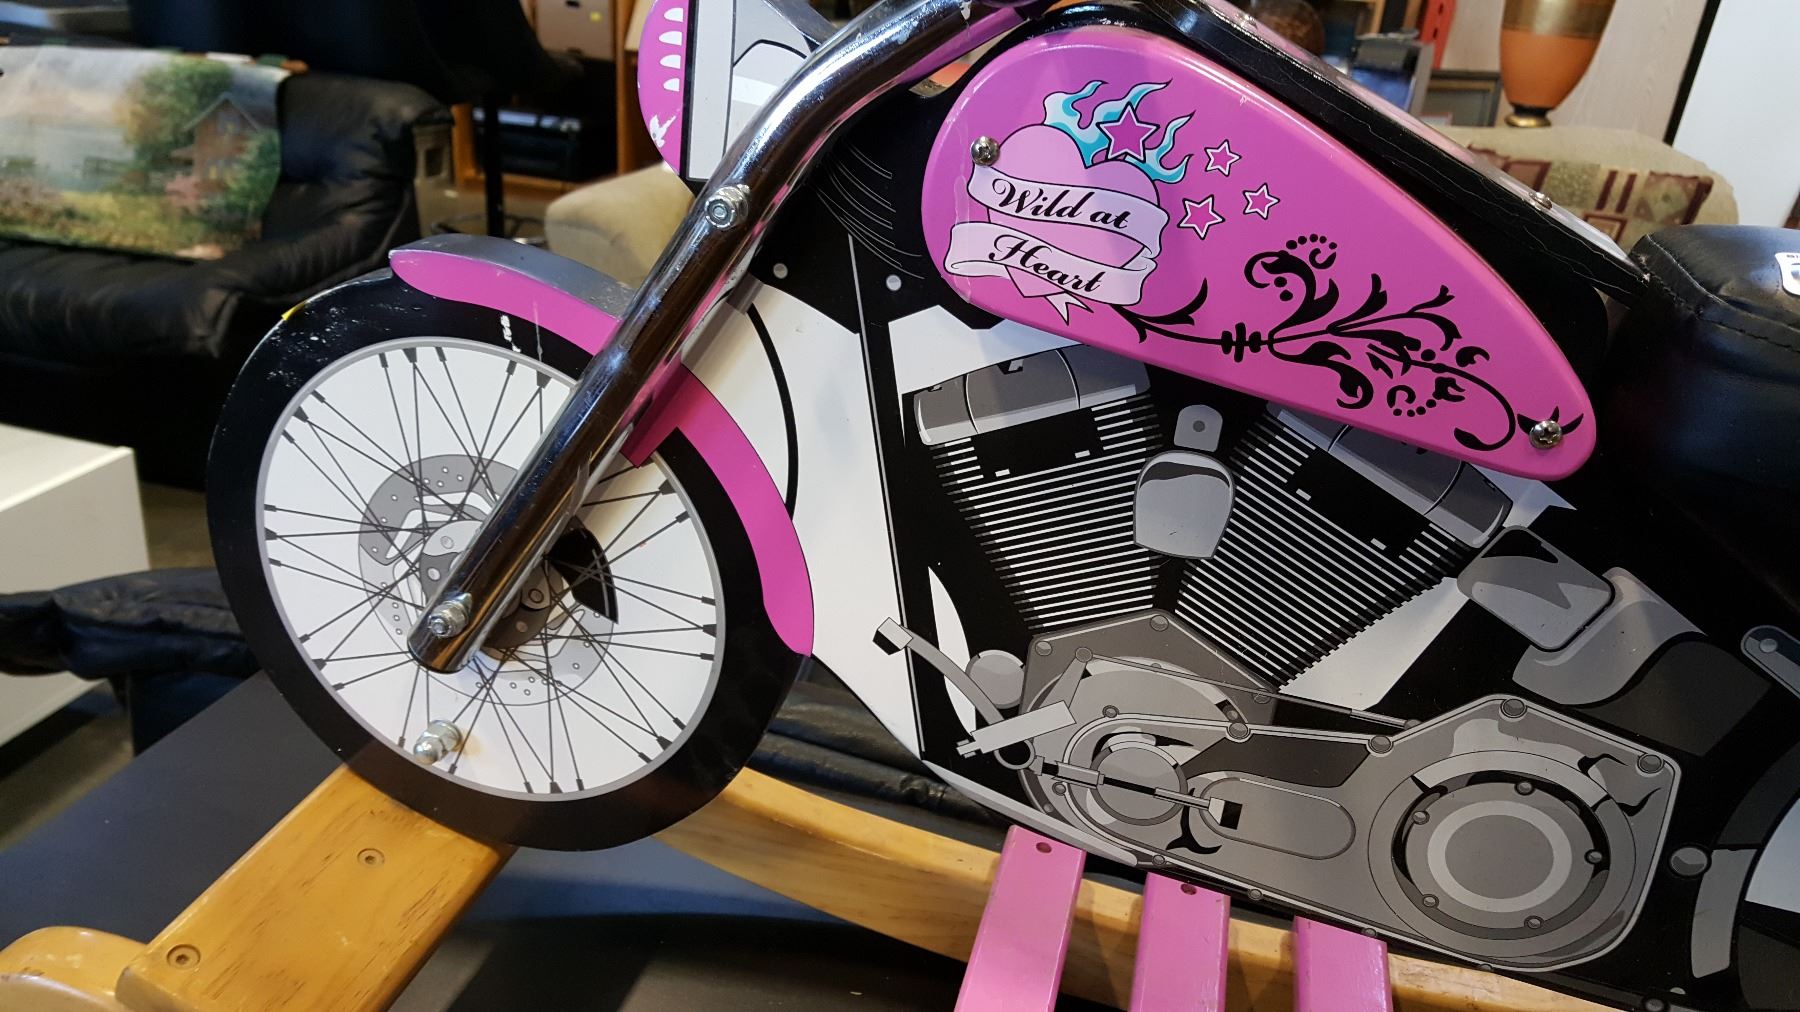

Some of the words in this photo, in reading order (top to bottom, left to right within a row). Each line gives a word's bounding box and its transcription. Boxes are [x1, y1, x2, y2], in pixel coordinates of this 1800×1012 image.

[992, 178, 1095, 219] Wild
[1090, 210, 1131, 229] at
[988, 234, 1106, 292] Heart
